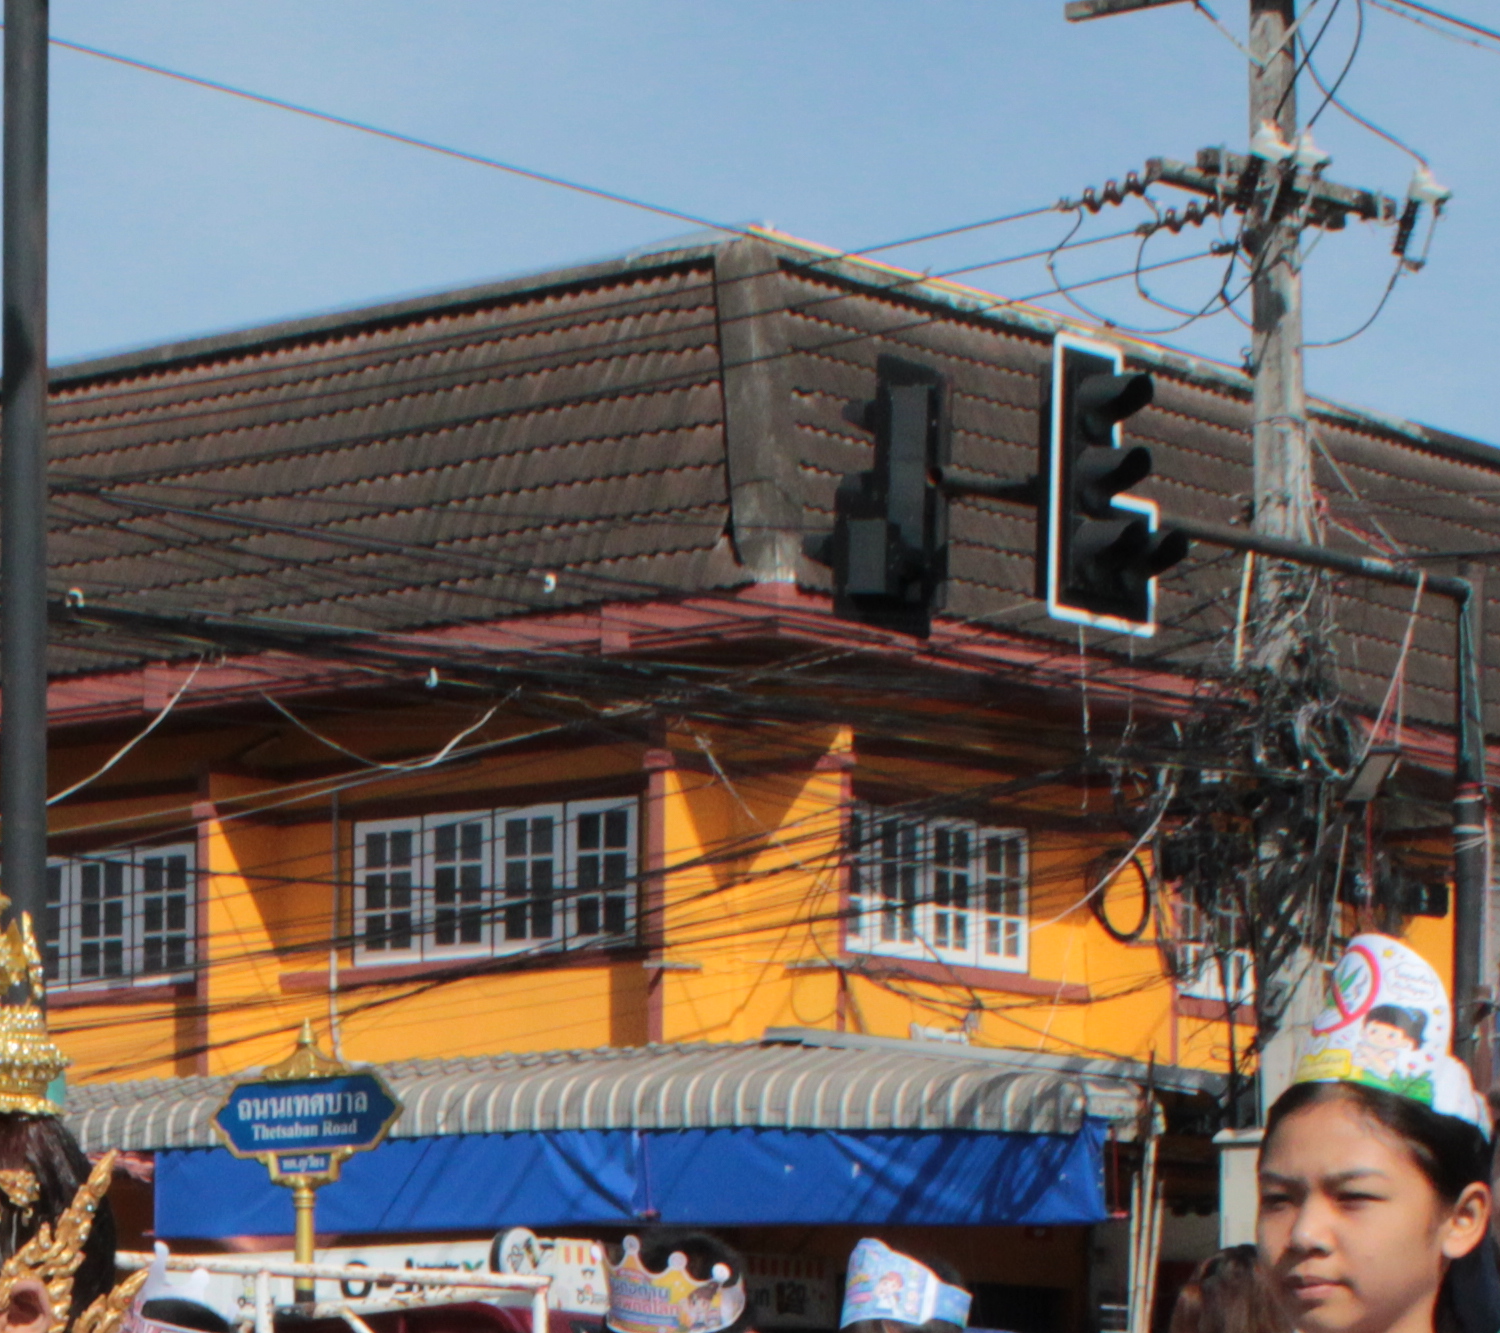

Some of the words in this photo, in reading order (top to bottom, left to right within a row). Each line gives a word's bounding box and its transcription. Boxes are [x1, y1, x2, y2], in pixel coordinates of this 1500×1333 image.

[237, 1090, 369, 1121] ถนนเทศบาล
[250, 1122, 319, 1141] Thetsaban
[321, 1118, 359, 1137] Road
